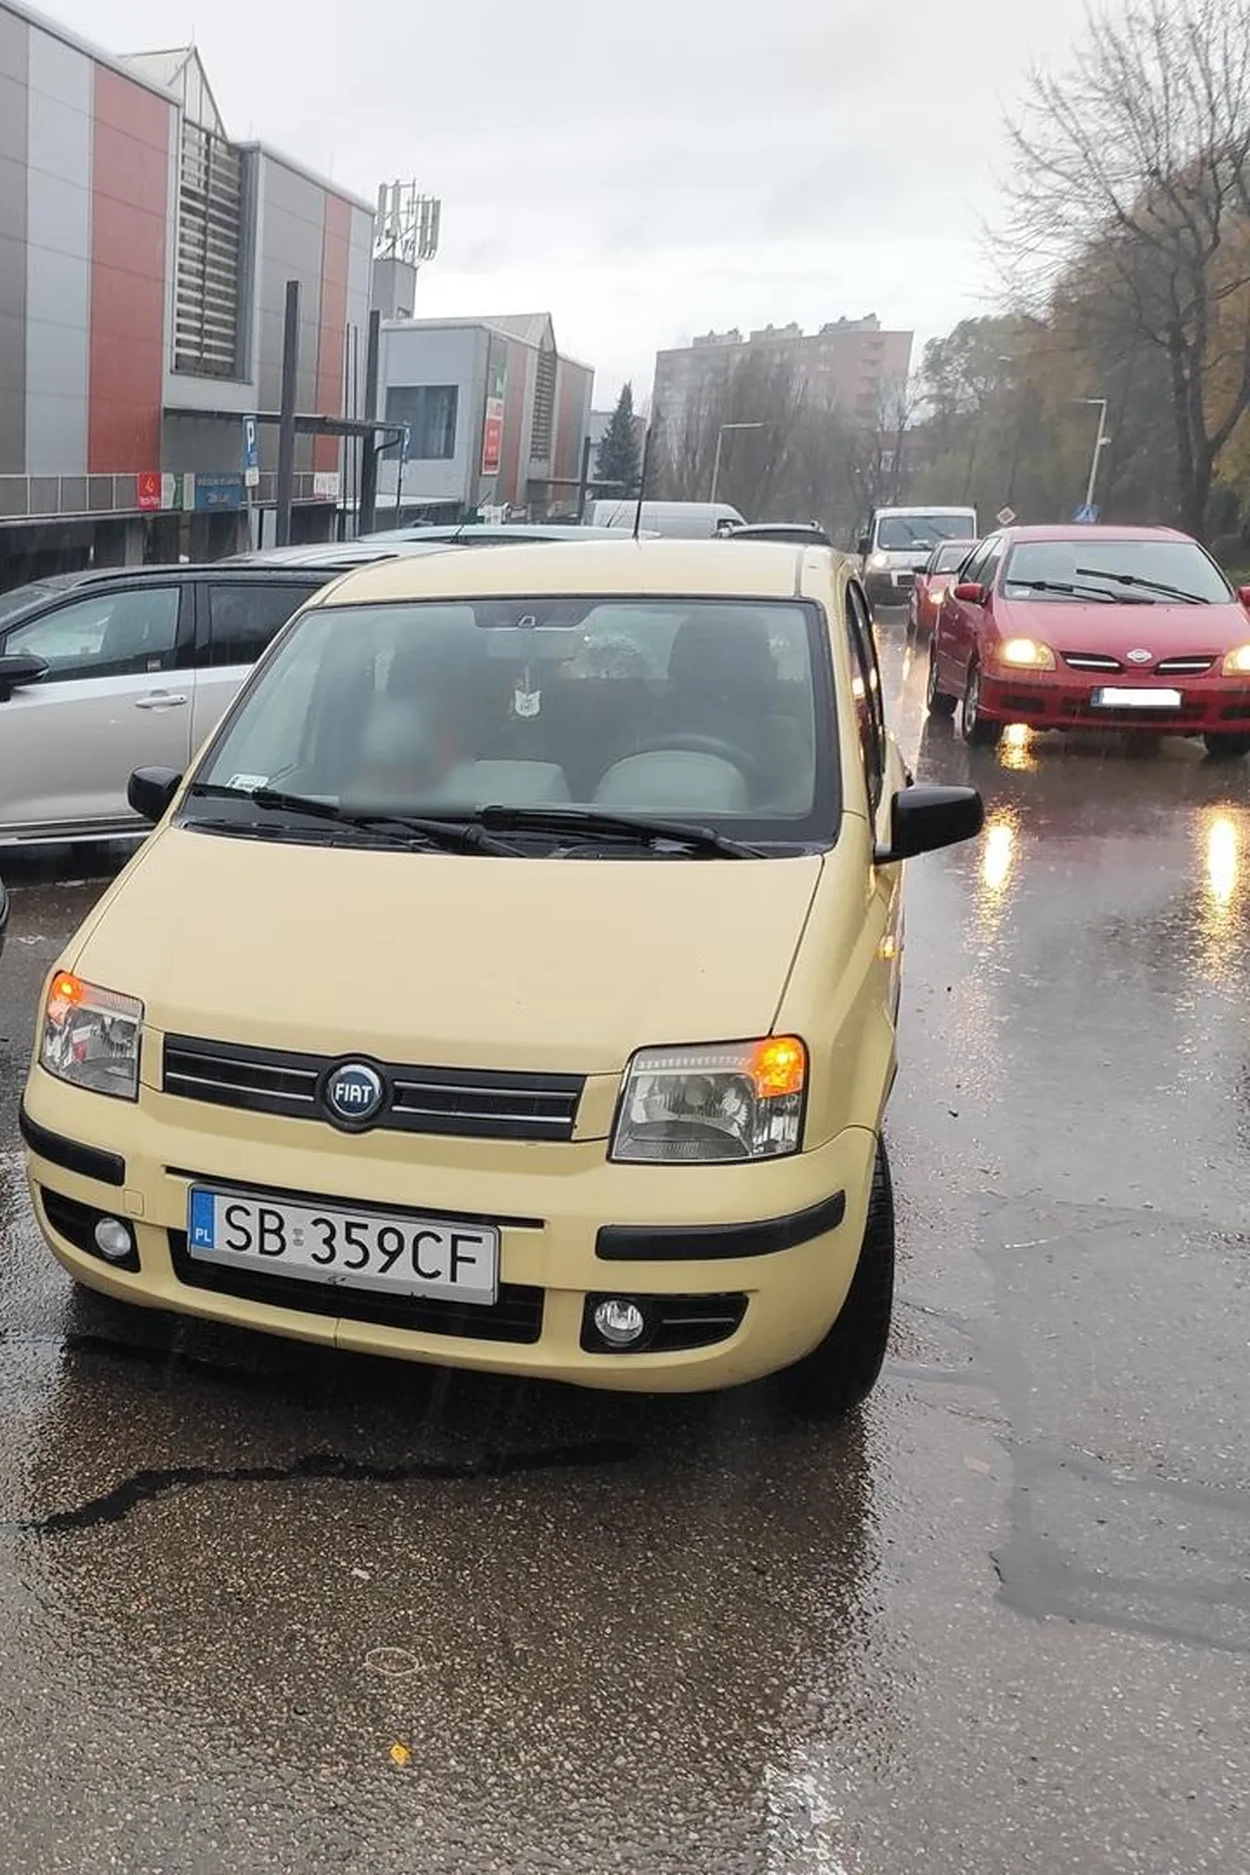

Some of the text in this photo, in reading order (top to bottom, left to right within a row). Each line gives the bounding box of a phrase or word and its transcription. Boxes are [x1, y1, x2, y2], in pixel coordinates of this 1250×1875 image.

[246, 420, 255, 453] P
[335, 1083, 373, 1103] FIAT
[195, 1228, 212, 1243] PL
[224, 1204, 483, 1283] SB 359CF
